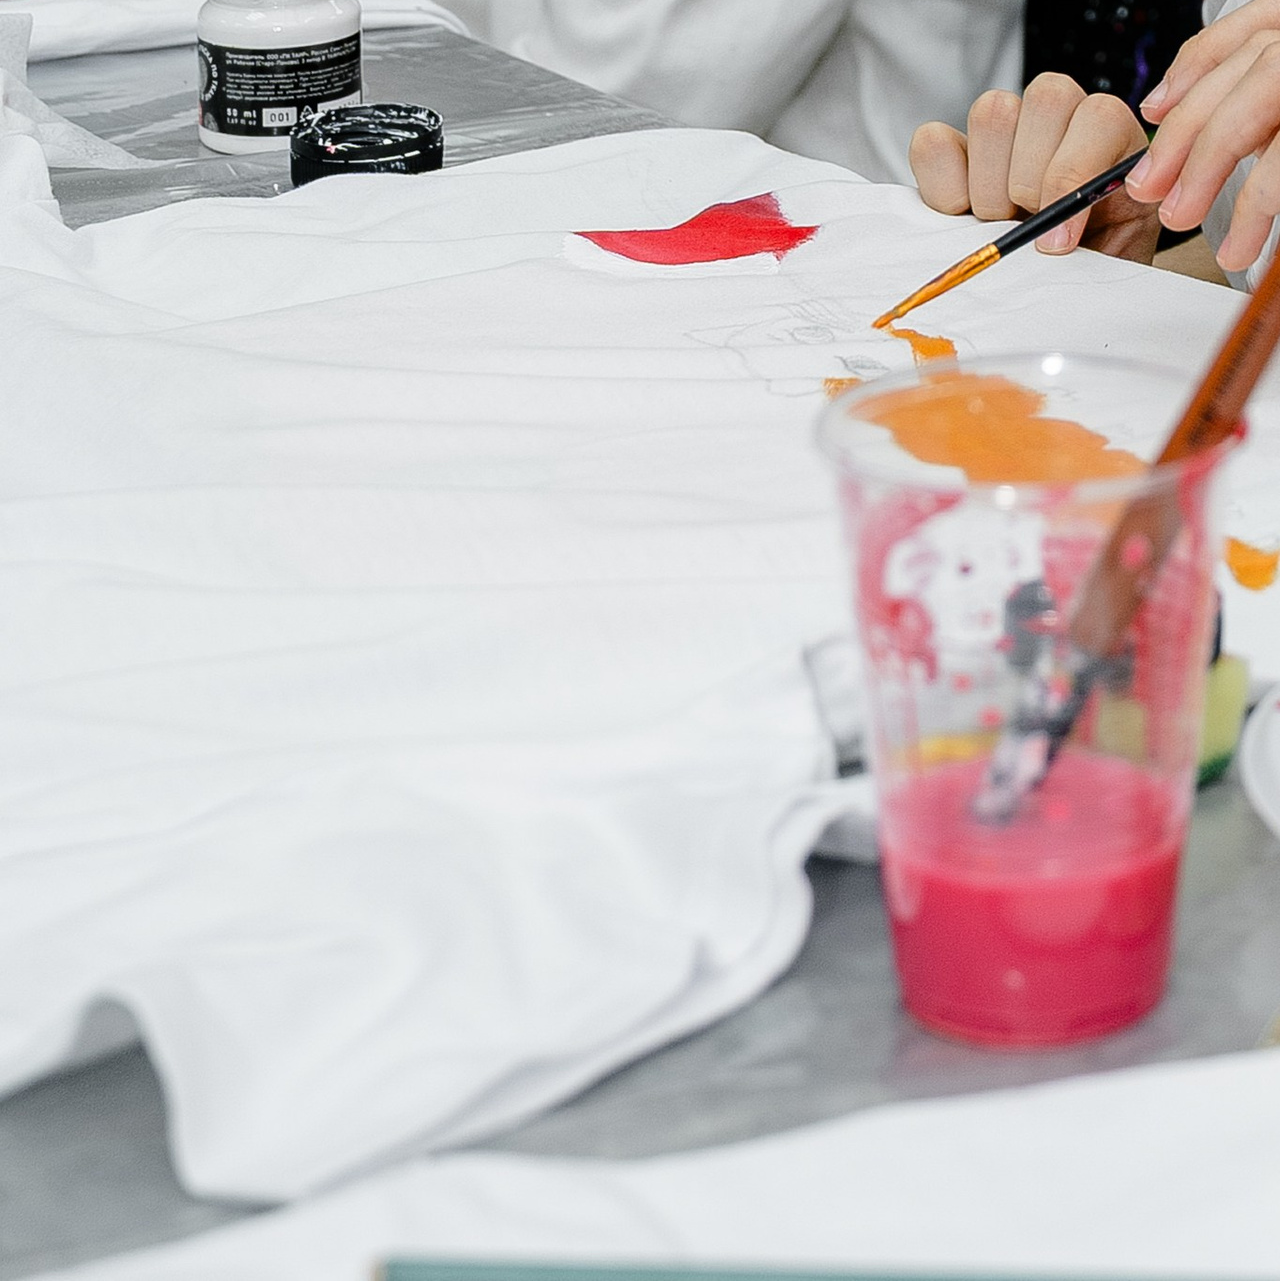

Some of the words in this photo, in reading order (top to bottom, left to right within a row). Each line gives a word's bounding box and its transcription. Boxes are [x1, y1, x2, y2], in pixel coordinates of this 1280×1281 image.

[226, 108, 238, 117] 50
[243, 108, 257, 118] ml
[269, 112, 290, 122] 001
